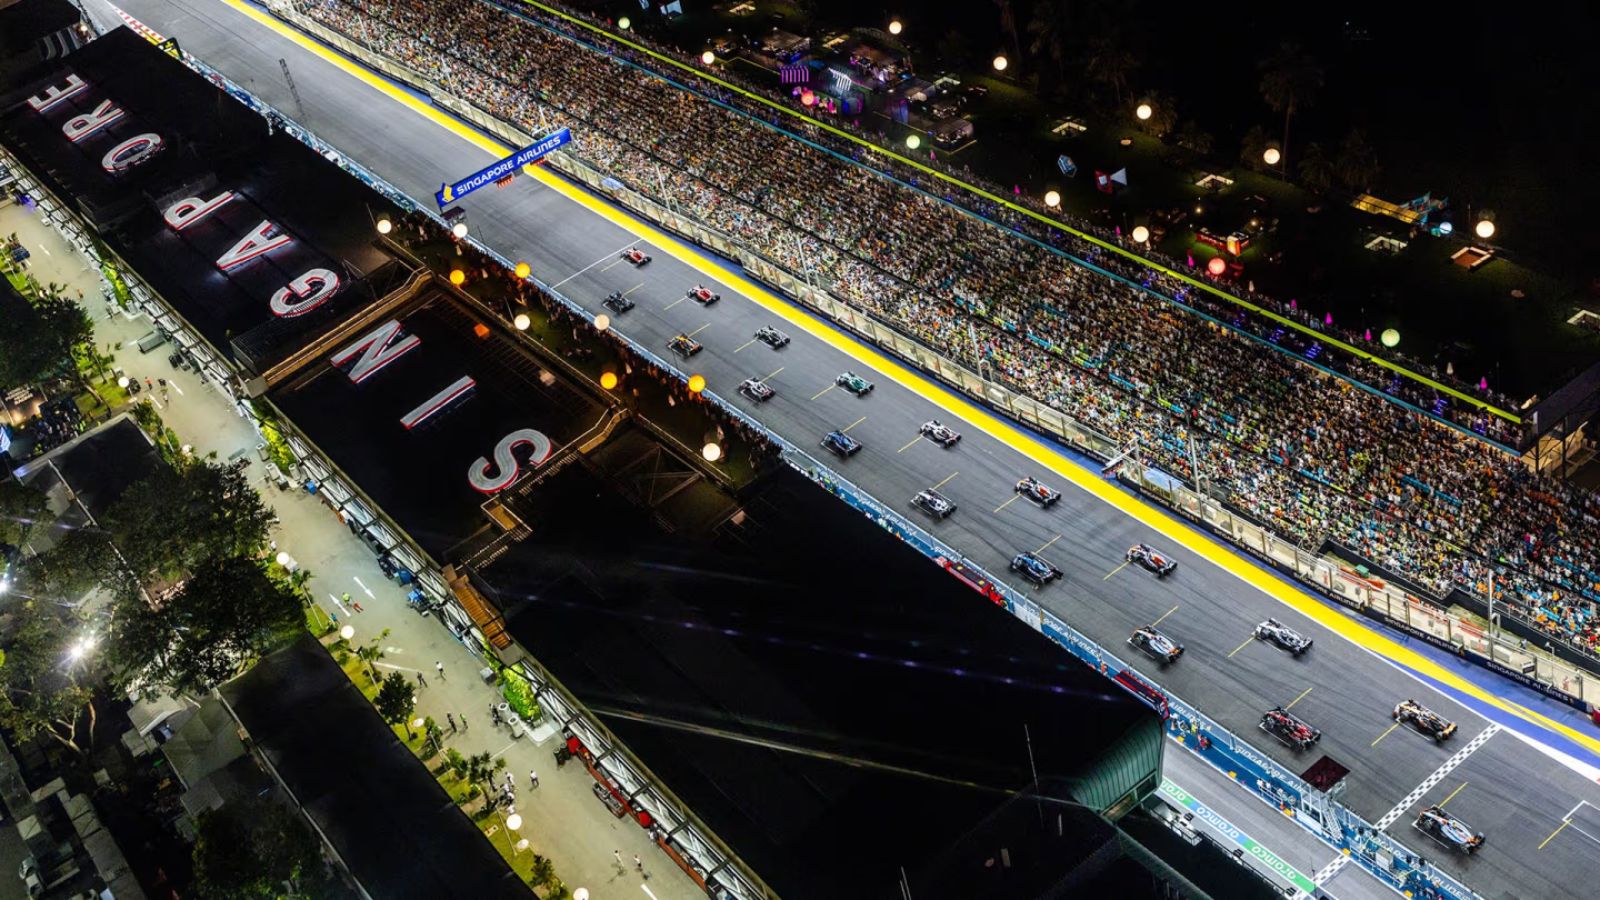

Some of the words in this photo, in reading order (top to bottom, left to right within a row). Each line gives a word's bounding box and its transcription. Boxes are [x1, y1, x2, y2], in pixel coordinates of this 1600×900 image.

[456, 160, 514, 195] SINGAPORE
[516, 135, 561, 165] AIRLINES
[1293, 571, 1328, 594] SIGAPORE
[1329, 592, 1360, 609] AIRLINE
[1486, 661, 1531, 684] SINGAPORE
[1532, 681, 1569, 701] AIINES
[1196, 806, 1240, 840] aramco
[1251, 845, 1297, 880] aramco
